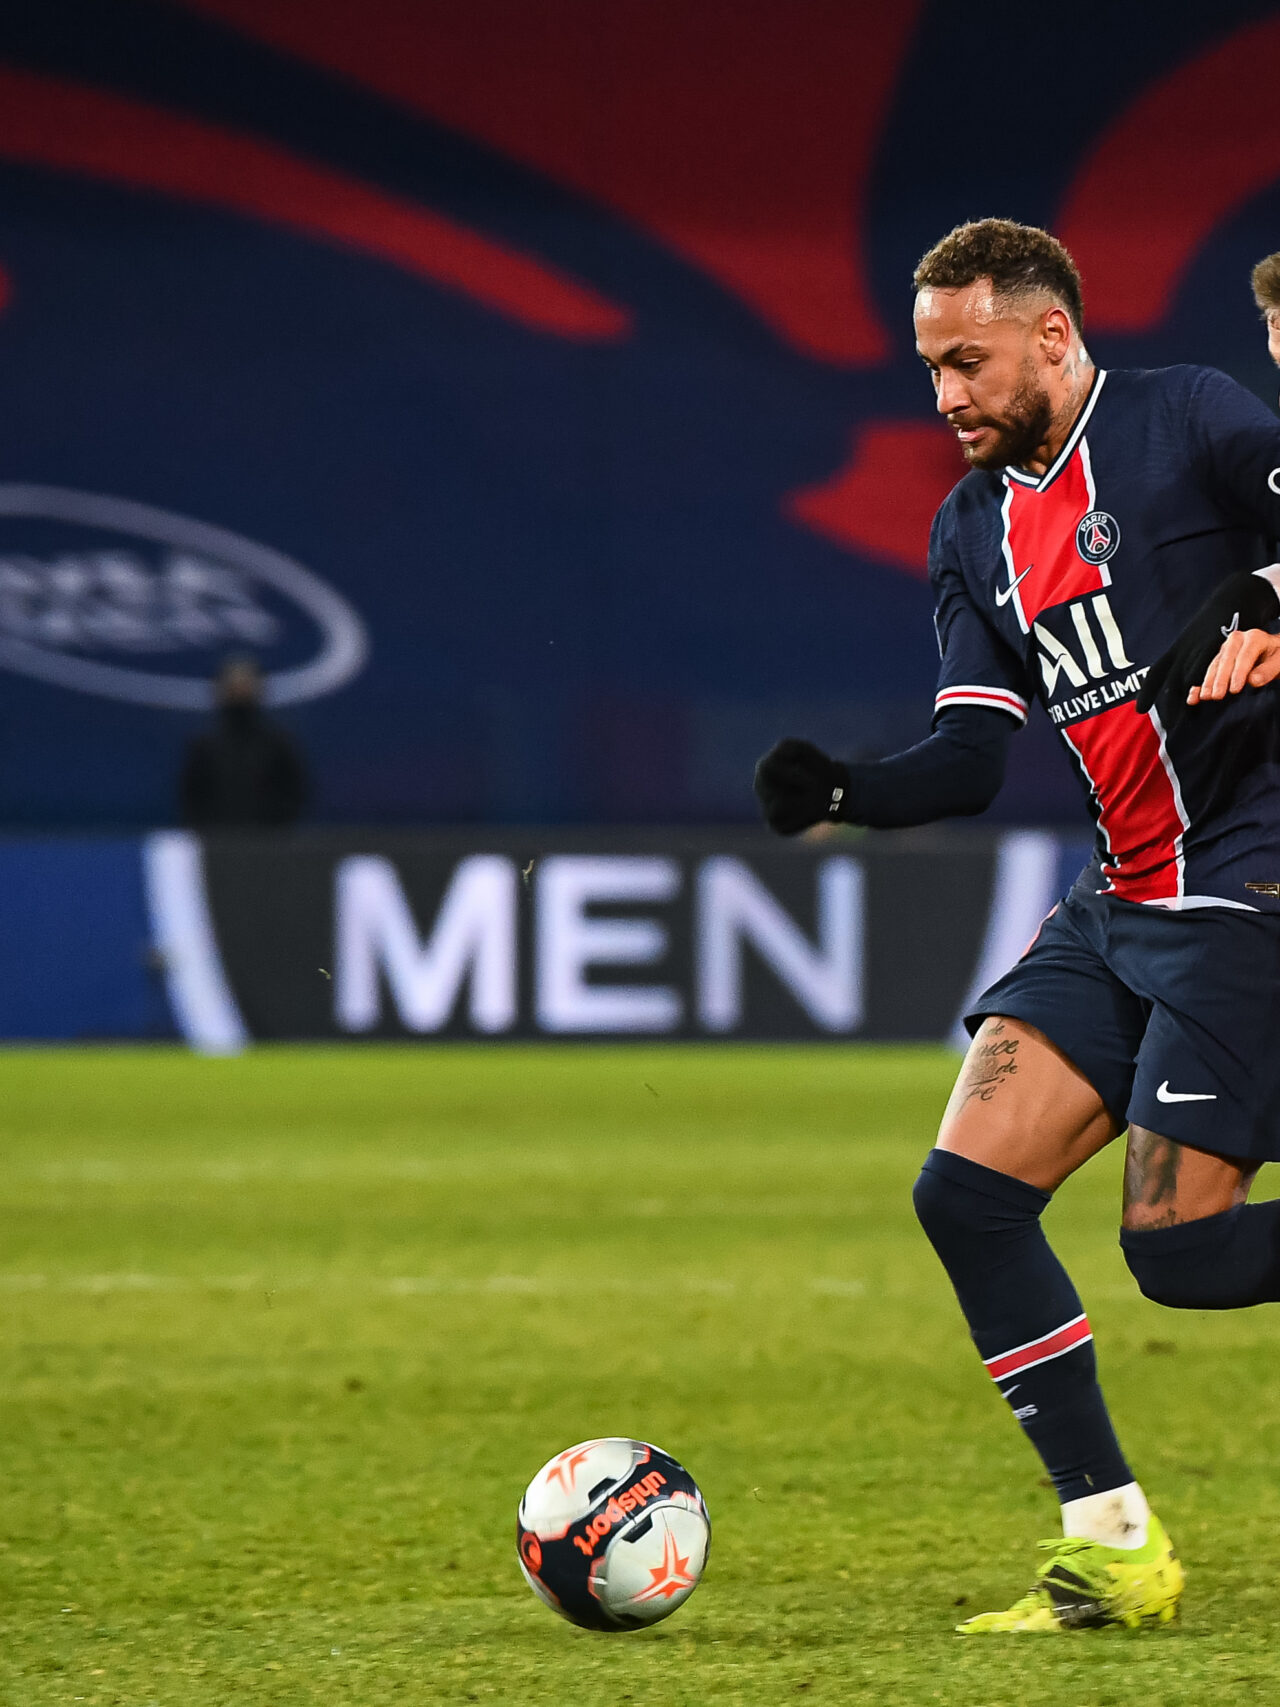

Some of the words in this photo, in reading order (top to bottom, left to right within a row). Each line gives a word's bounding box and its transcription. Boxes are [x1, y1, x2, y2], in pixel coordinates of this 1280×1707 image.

[1080, 514, 1108, 532] PARIS
[1063, 689, 1101, 719] LIVE
[334, 855, 866, 1034] MEN
[573, 1470, 668, 1556] uhlsport
